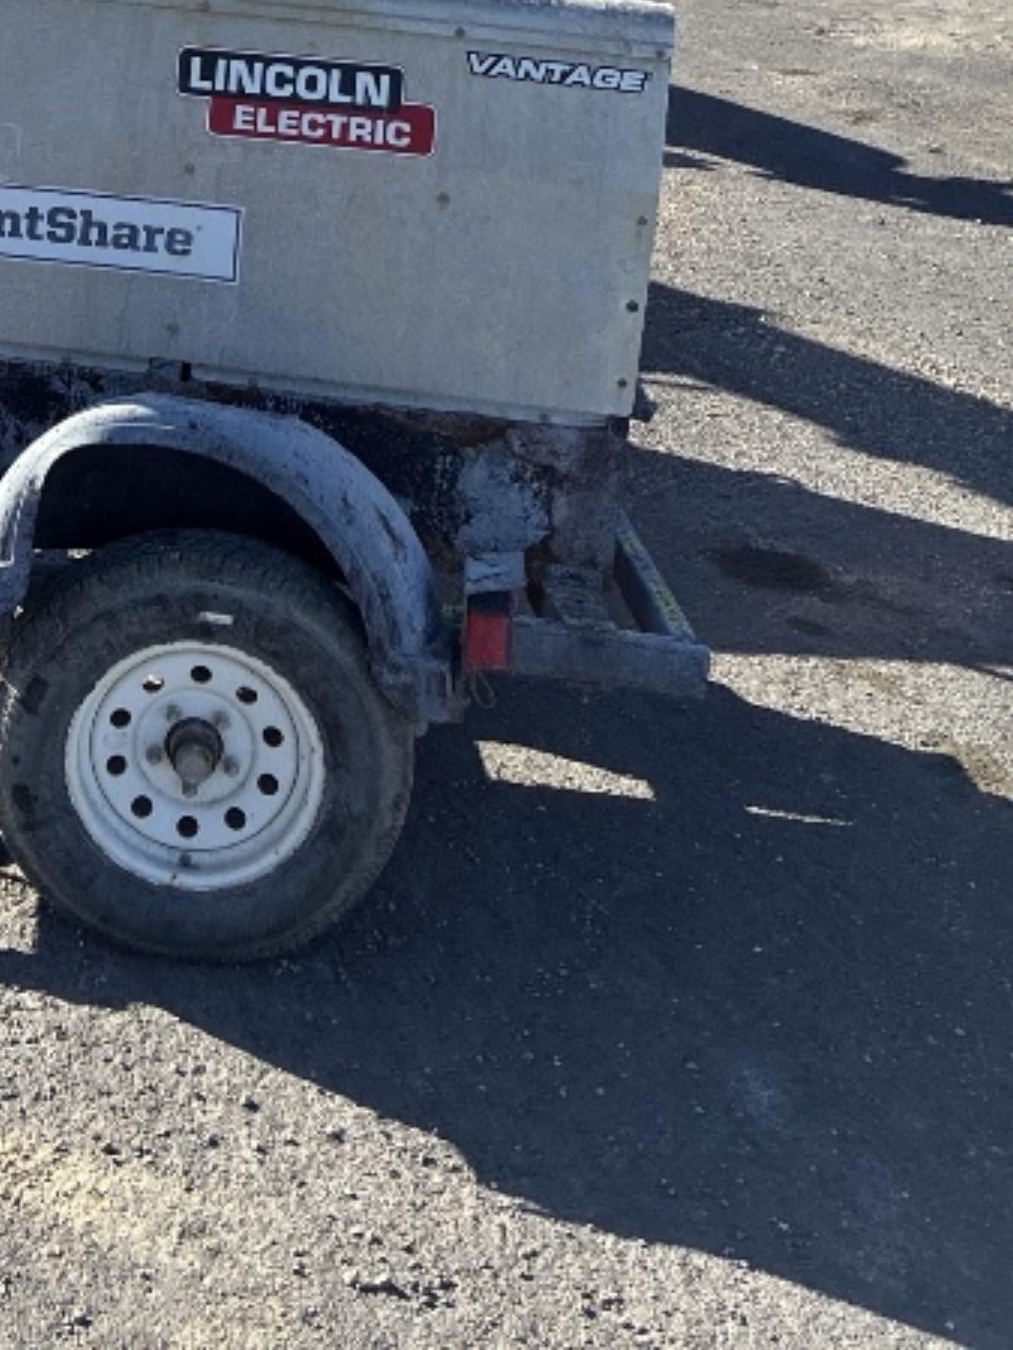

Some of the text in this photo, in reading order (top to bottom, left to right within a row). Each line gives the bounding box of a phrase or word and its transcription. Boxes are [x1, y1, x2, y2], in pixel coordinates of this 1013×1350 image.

[189, 56, 391, 107] LINCOLN
[467, 51, 648, 93] VANTAGE
[232, 104, 412, 146] ELECTRIC
